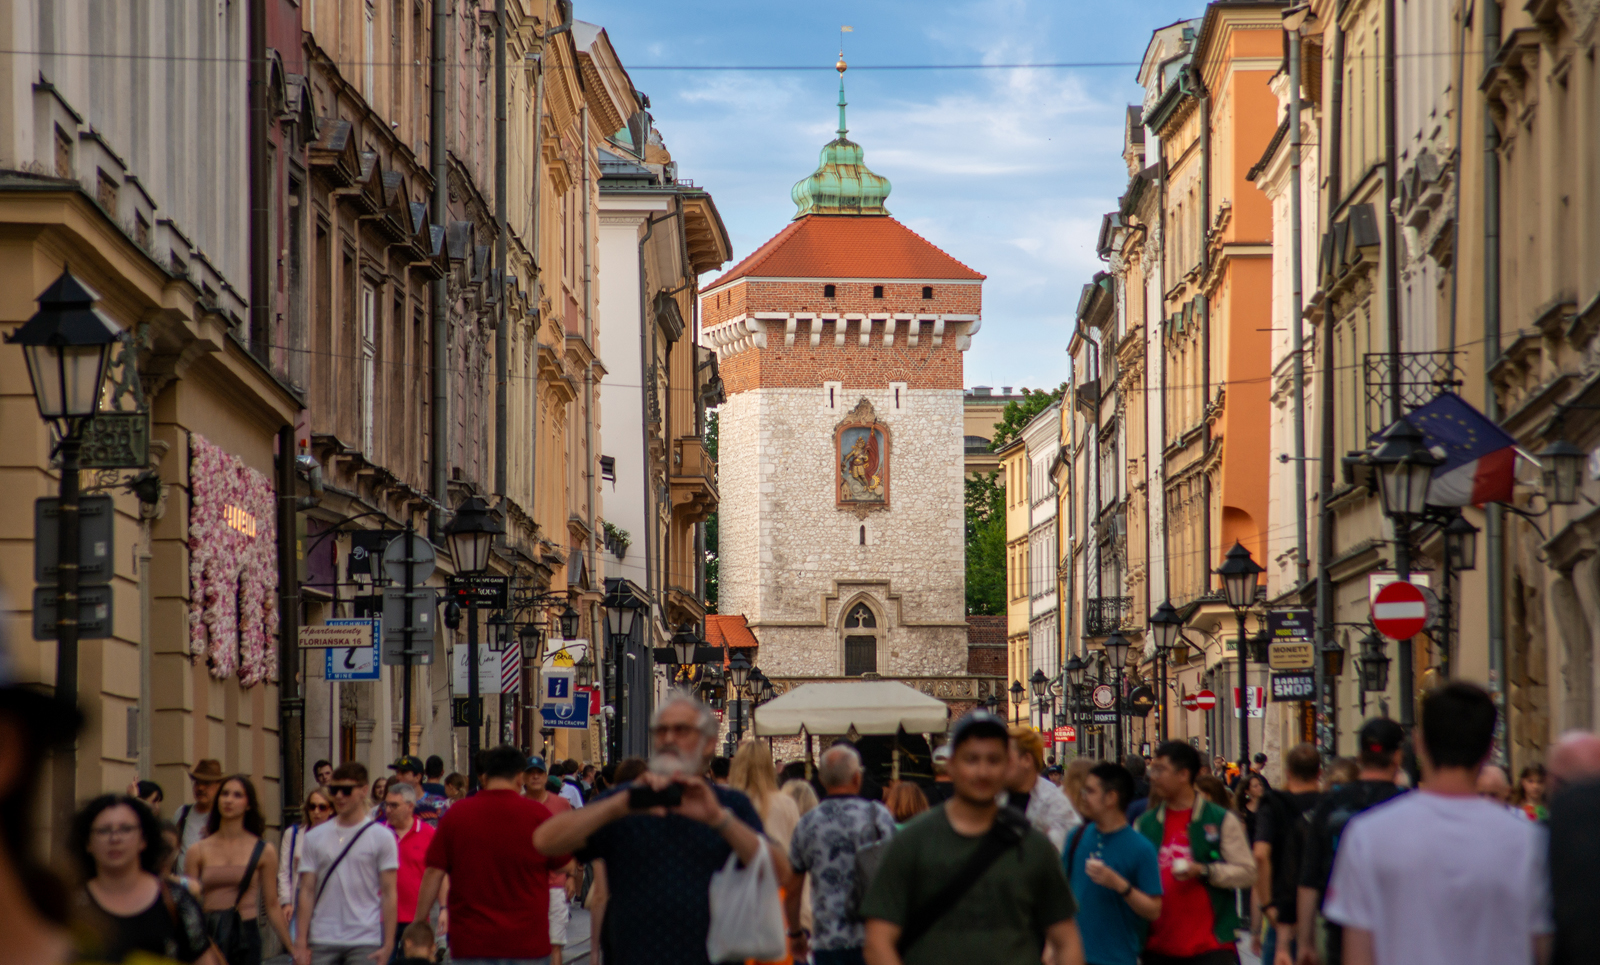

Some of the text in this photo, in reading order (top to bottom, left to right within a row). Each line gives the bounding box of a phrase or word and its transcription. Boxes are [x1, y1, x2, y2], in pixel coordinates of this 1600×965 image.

[299, 626, 361, 636] Apartamenty
[525, 641, 535, 649] 20
[1273, 645, 1308, 653] MONETY
[1274, 676, 1312, 685] BARBER
[1274, 684, 1313, 696] SHOP
